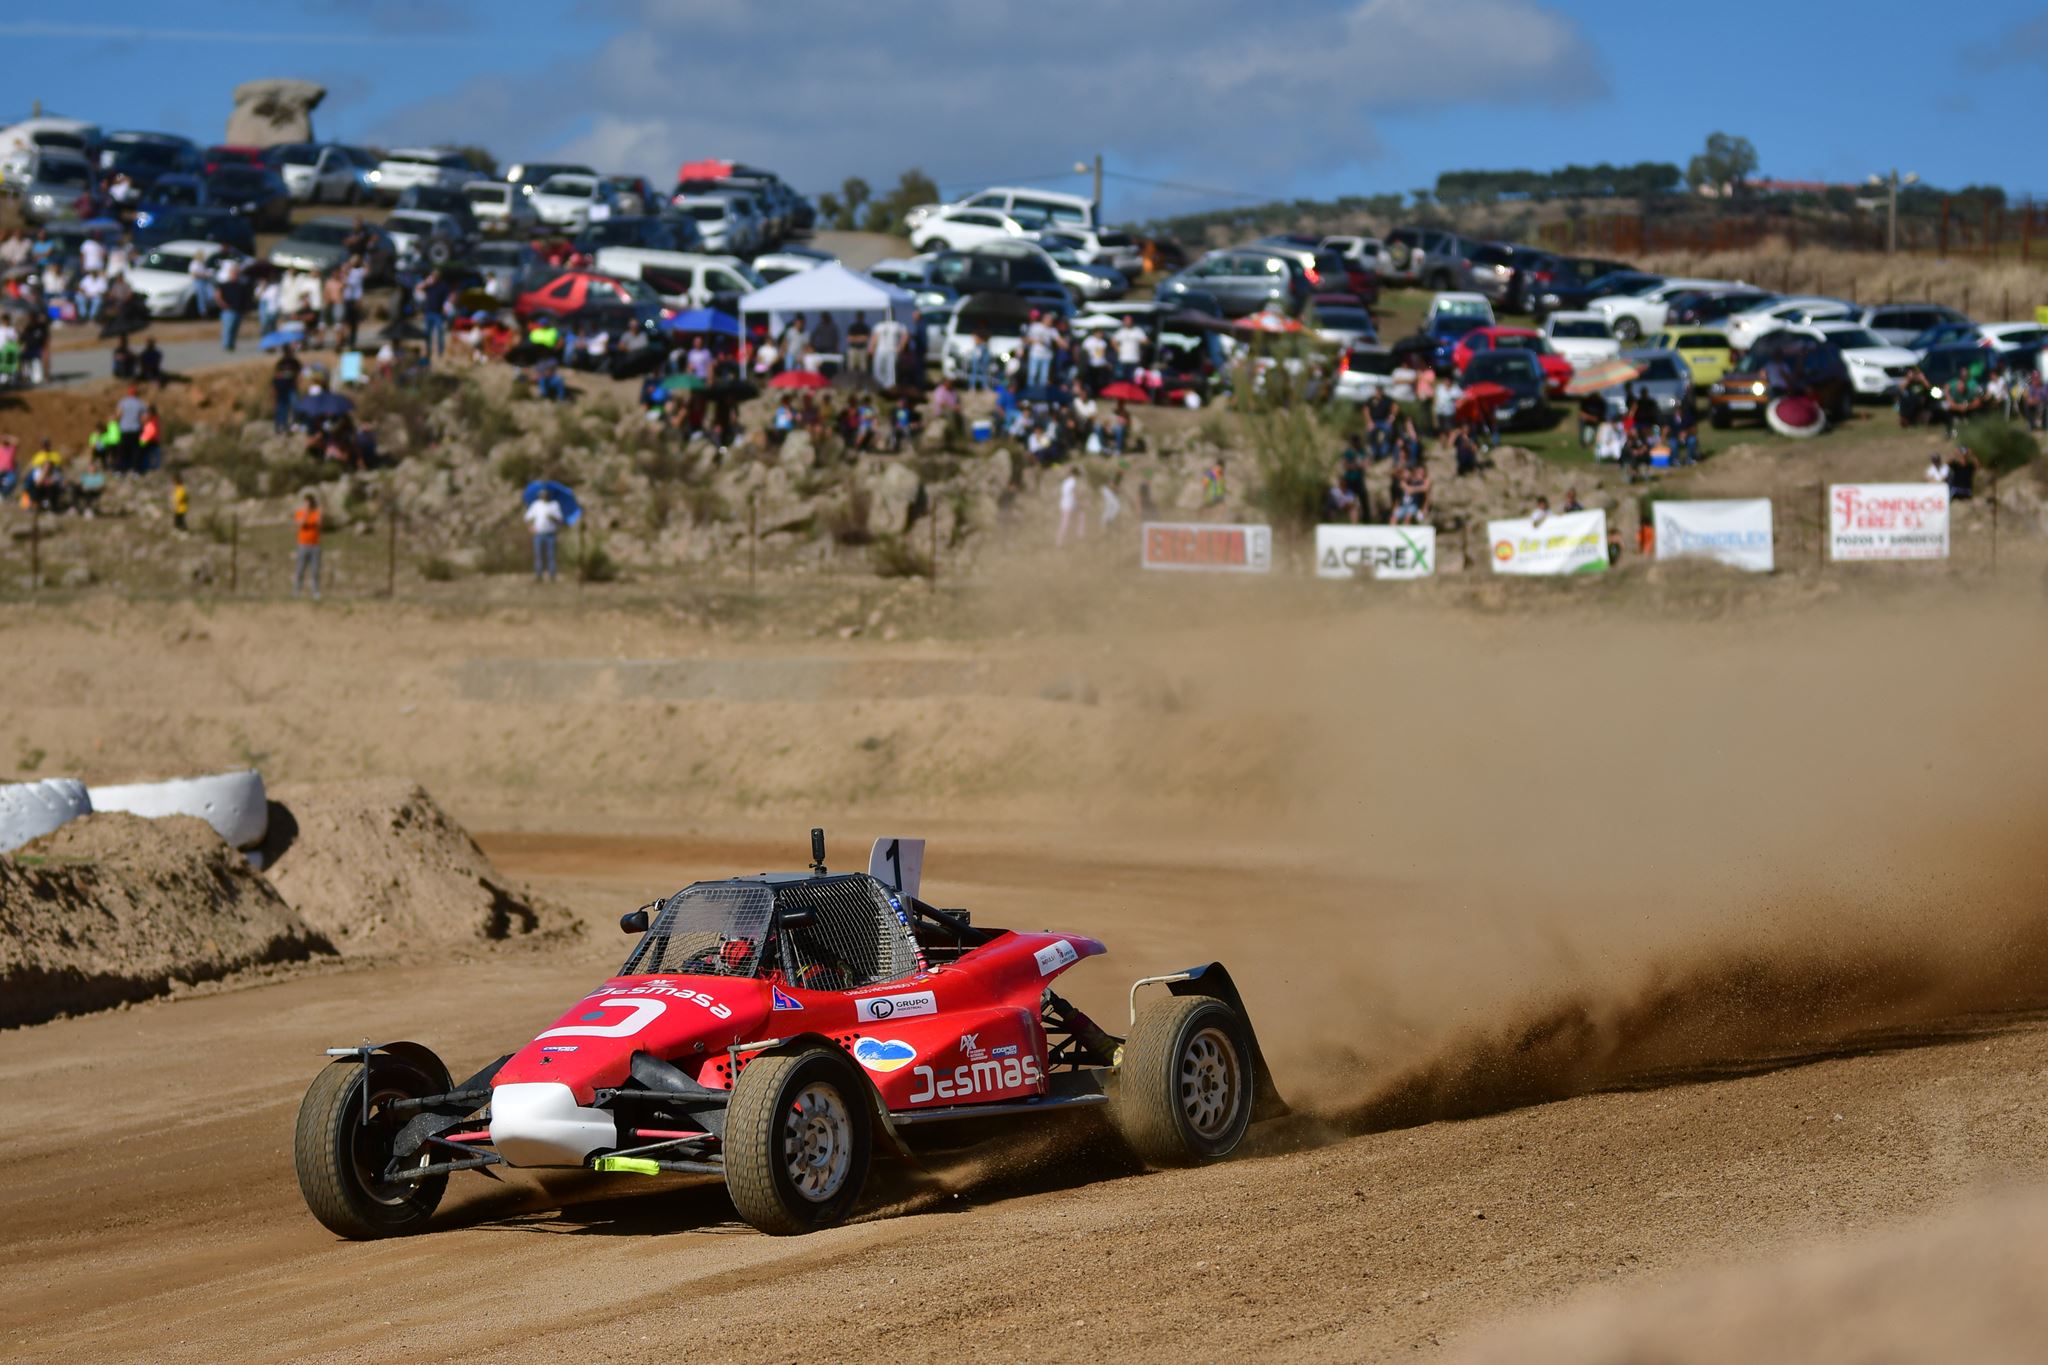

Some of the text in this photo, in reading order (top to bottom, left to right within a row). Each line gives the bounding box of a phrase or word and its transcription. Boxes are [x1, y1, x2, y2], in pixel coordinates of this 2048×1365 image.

[1321, 530, 1428, 571] ACEREX
[886, 839, 902, 891] 1
[896, 998, 929, 1008] GRUPO
[992, 1045, 1017, 1054] COOPER
